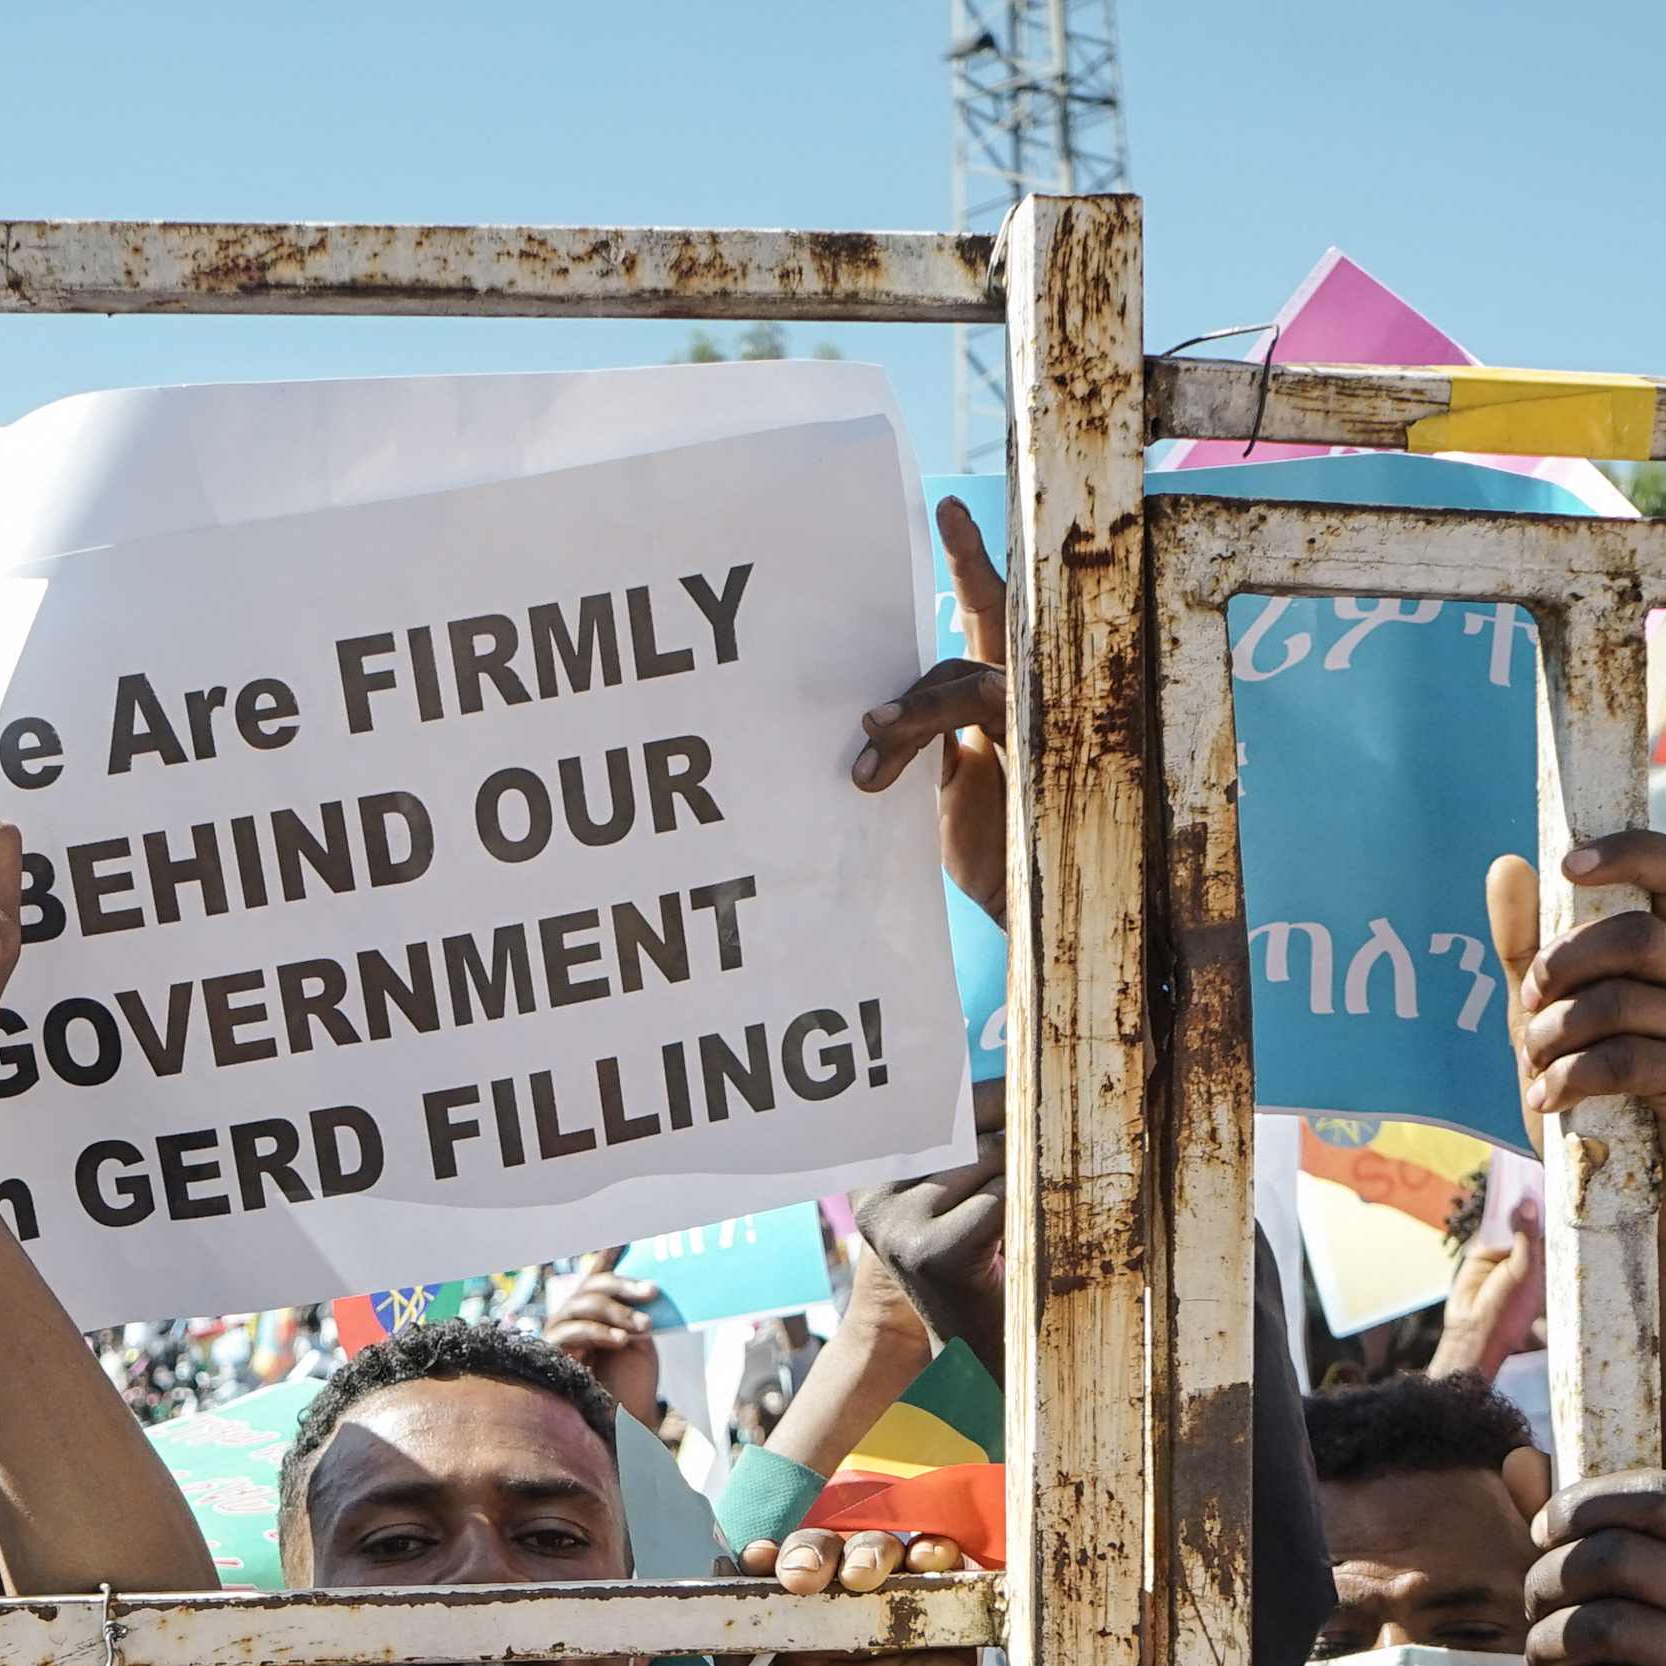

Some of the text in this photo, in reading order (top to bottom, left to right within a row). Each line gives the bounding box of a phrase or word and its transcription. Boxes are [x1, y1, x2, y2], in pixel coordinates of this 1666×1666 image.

[108, 672, 301, 776] Are
[335, 562, 755, 735] FIRMLY
[20, 733, 726, 946] BEHIND OUR
[74, 1105, 385, 1228] GERD
[421, 997, 889, 1181] FILLING!
